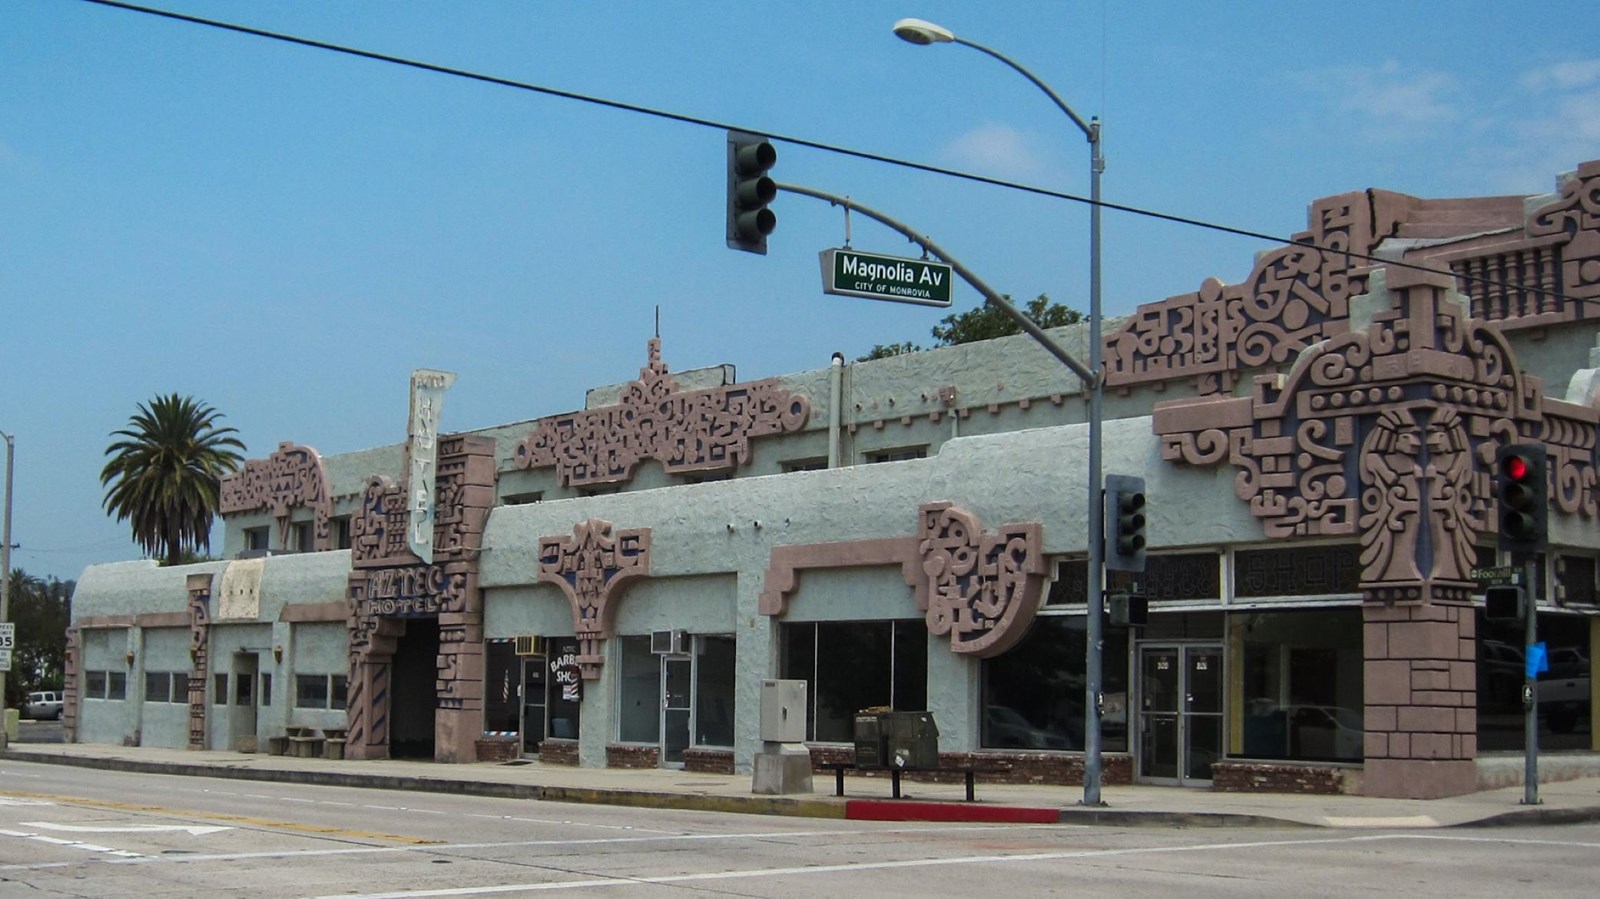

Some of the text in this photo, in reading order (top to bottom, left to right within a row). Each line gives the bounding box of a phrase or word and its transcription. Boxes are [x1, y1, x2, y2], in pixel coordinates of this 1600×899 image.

[843, 255, 943, 286] Magnolia Av
[854, 281, 931, 298] CITY OF MONROVIA
[415, 396, 433, 544] HOTEL
[368, 565, 443, 599] AZTEC
[1248, 549, 1355, 593] SHOP
[368, 598, 438, 615] HOTEL
[550, 654, 582, 672] BARB
